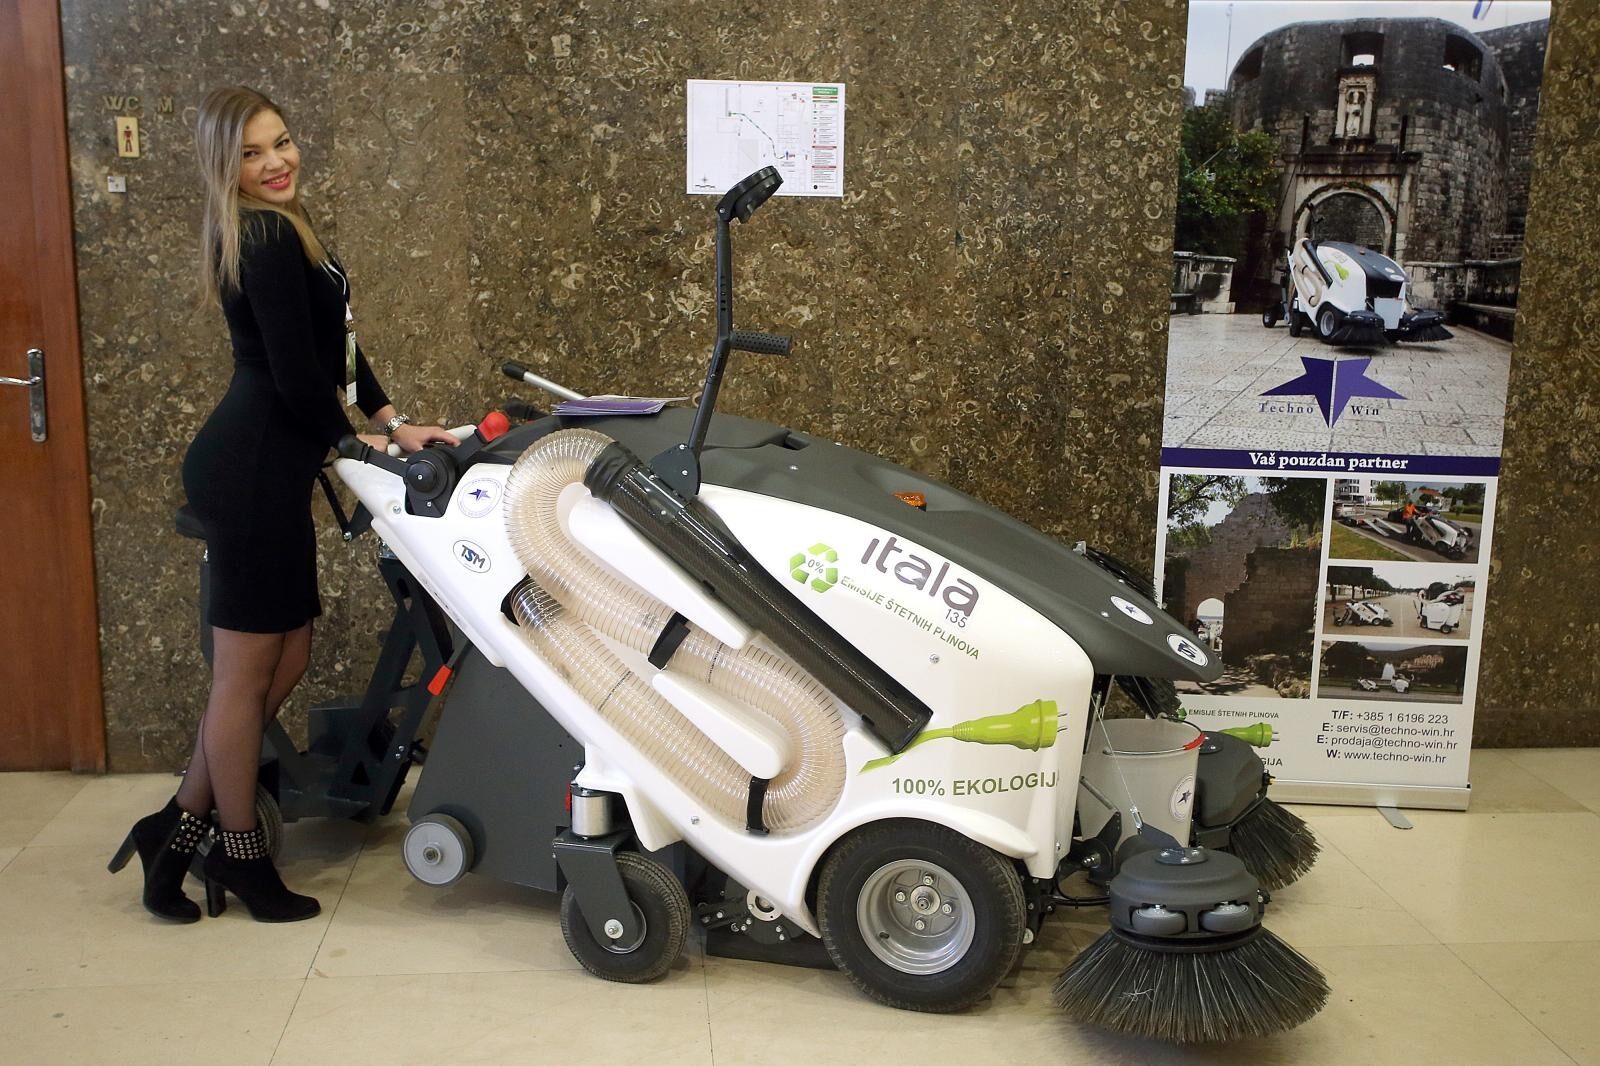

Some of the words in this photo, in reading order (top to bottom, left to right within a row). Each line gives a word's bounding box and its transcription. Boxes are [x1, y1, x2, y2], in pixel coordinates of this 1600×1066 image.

[102, 95, 139, 111] WC
[160, 95, 174, 112] M
[1259, 402, 1314, 414] Techno
[1351, 405, 1379, 416] Win
[1249, 452, 1276, 466] Vaš
[1278, 454, 1345, 469] pouzdan
[1349, 456, 1409, 471] partner
[461, 544, 486, 569] TSM
[807, 558, 824, 574] 0%
[885, 598, 933, 632] ŠTETNIH
[933, 625, 980, 660] PLINOVA
[945, 608, 968, 628] 135
[1217, 709, 1247, 718] ŠTETNIH
[1249, 711, 1279, 719] PLINOVA
[1332, 710, 1353, 720] T/F:
[1356, 711, 1384, 721] +385
[1388, 713, 1393, 722] 1
[1397, 713, 1425, 723] 6196
[1428, 714, 1449, 725] 223
[1322, 722, 1334, 732] E:
[1336, 724, 1455, 736] servis@techno-win.hr
[1316, 734, 1328, 744] E:
[1331, 736, 1457, 749] prodaja@techno-win.hr
[1326, 749, 1341, 759] W:
[1344, 752, 1446, 763] www.techno-win.hr
[892, 777, 945, 796] 100%
[953, 771, 1060, 796] EKOLOGIJ
